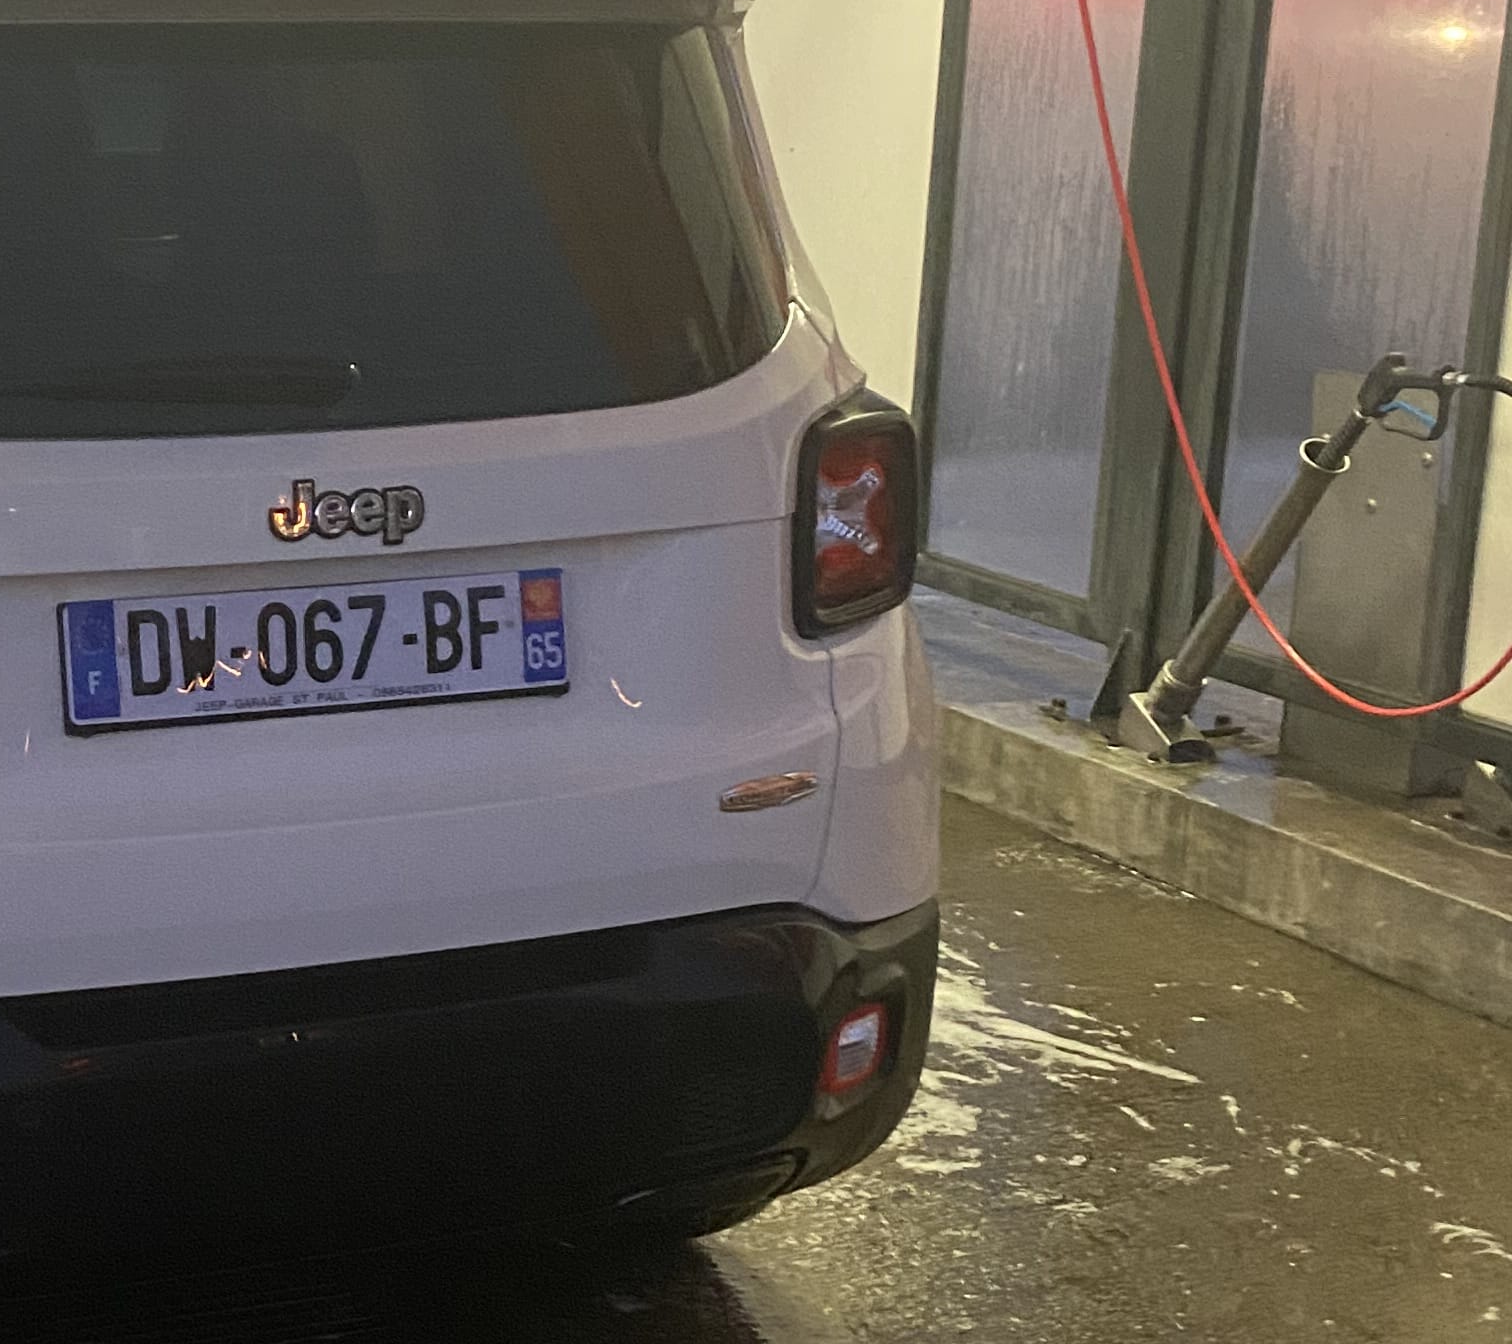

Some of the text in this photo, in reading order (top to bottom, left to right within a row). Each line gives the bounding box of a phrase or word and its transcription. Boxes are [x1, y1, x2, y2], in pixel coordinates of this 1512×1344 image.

[268, 478, 426, 546] Jeep
[526, 630, 564, 670] 65
[88, 669, 102, 695] F
